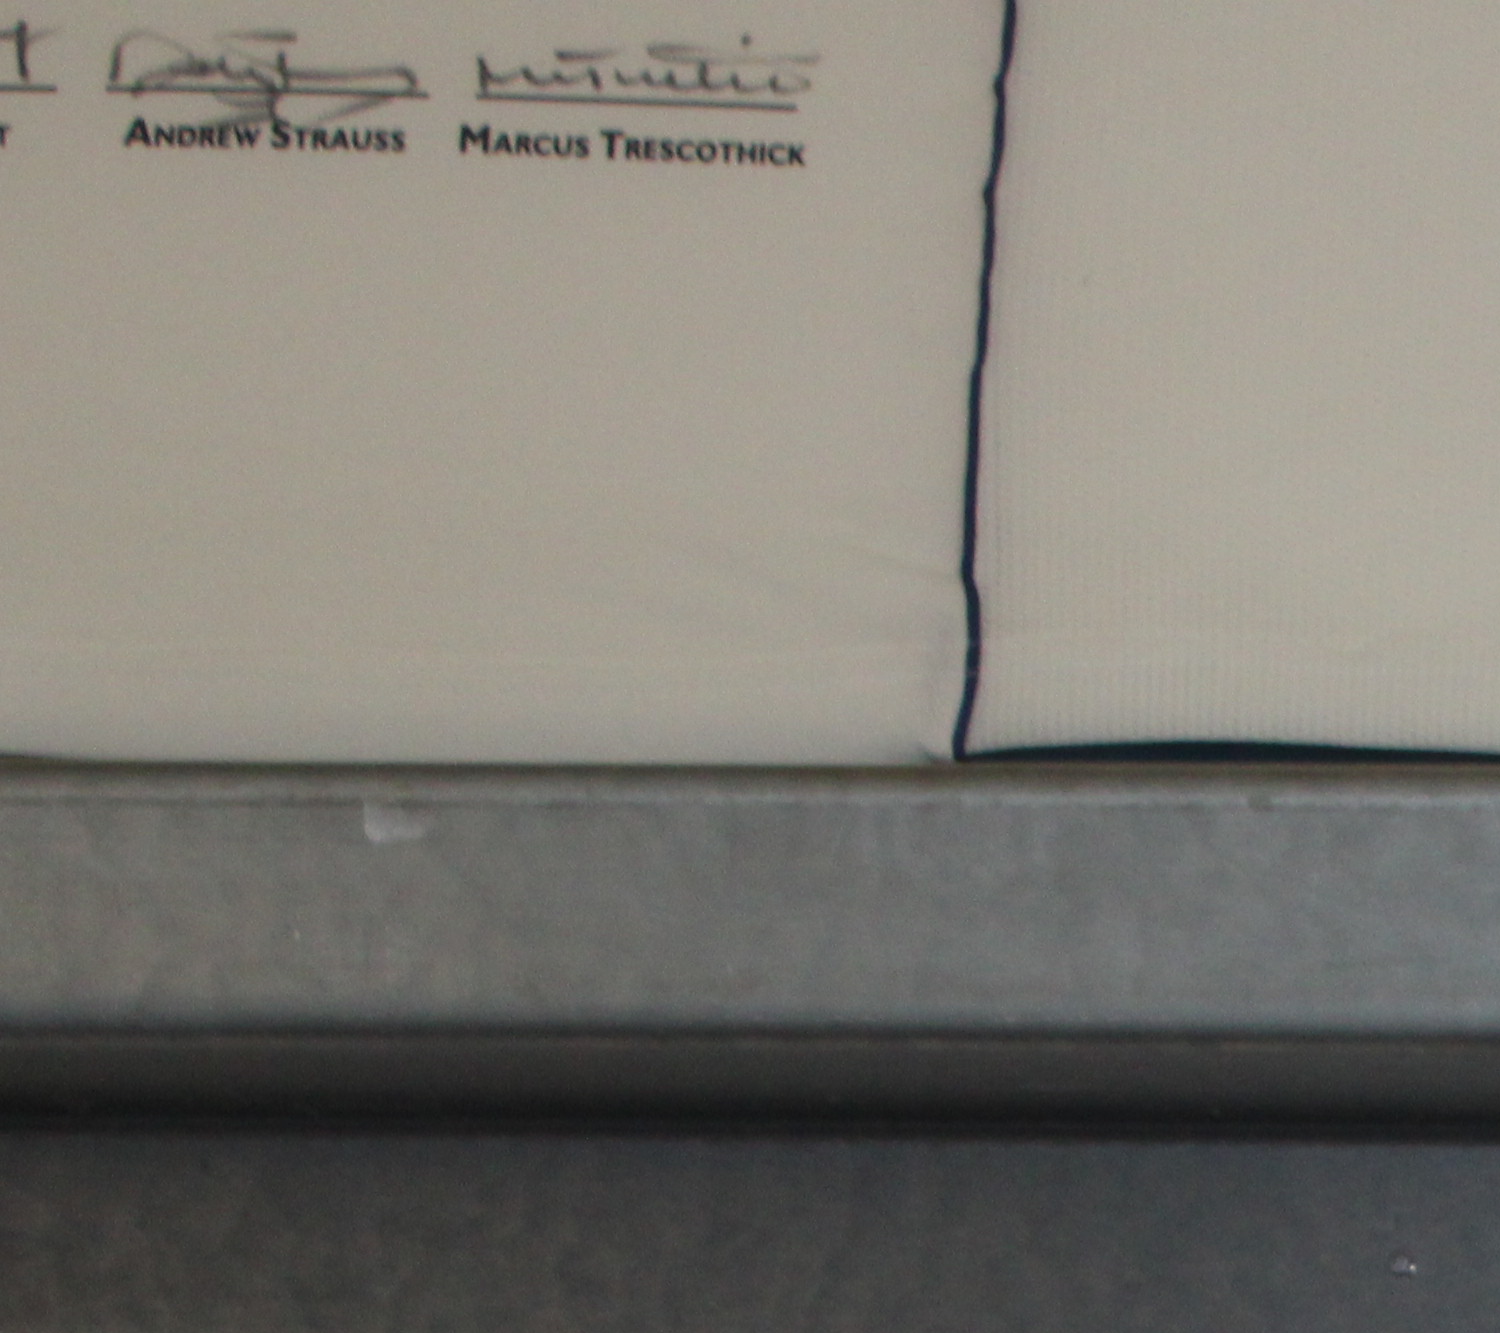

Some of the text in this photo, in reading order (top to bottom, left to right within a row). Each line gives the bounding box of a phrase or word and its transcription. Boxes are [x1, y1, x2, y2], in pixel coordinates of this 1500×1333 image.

[124, 116, 408, 153] ANDREW STRAUSS
[459, 124, 806, 167] MARCUS TRESCOTHICK
